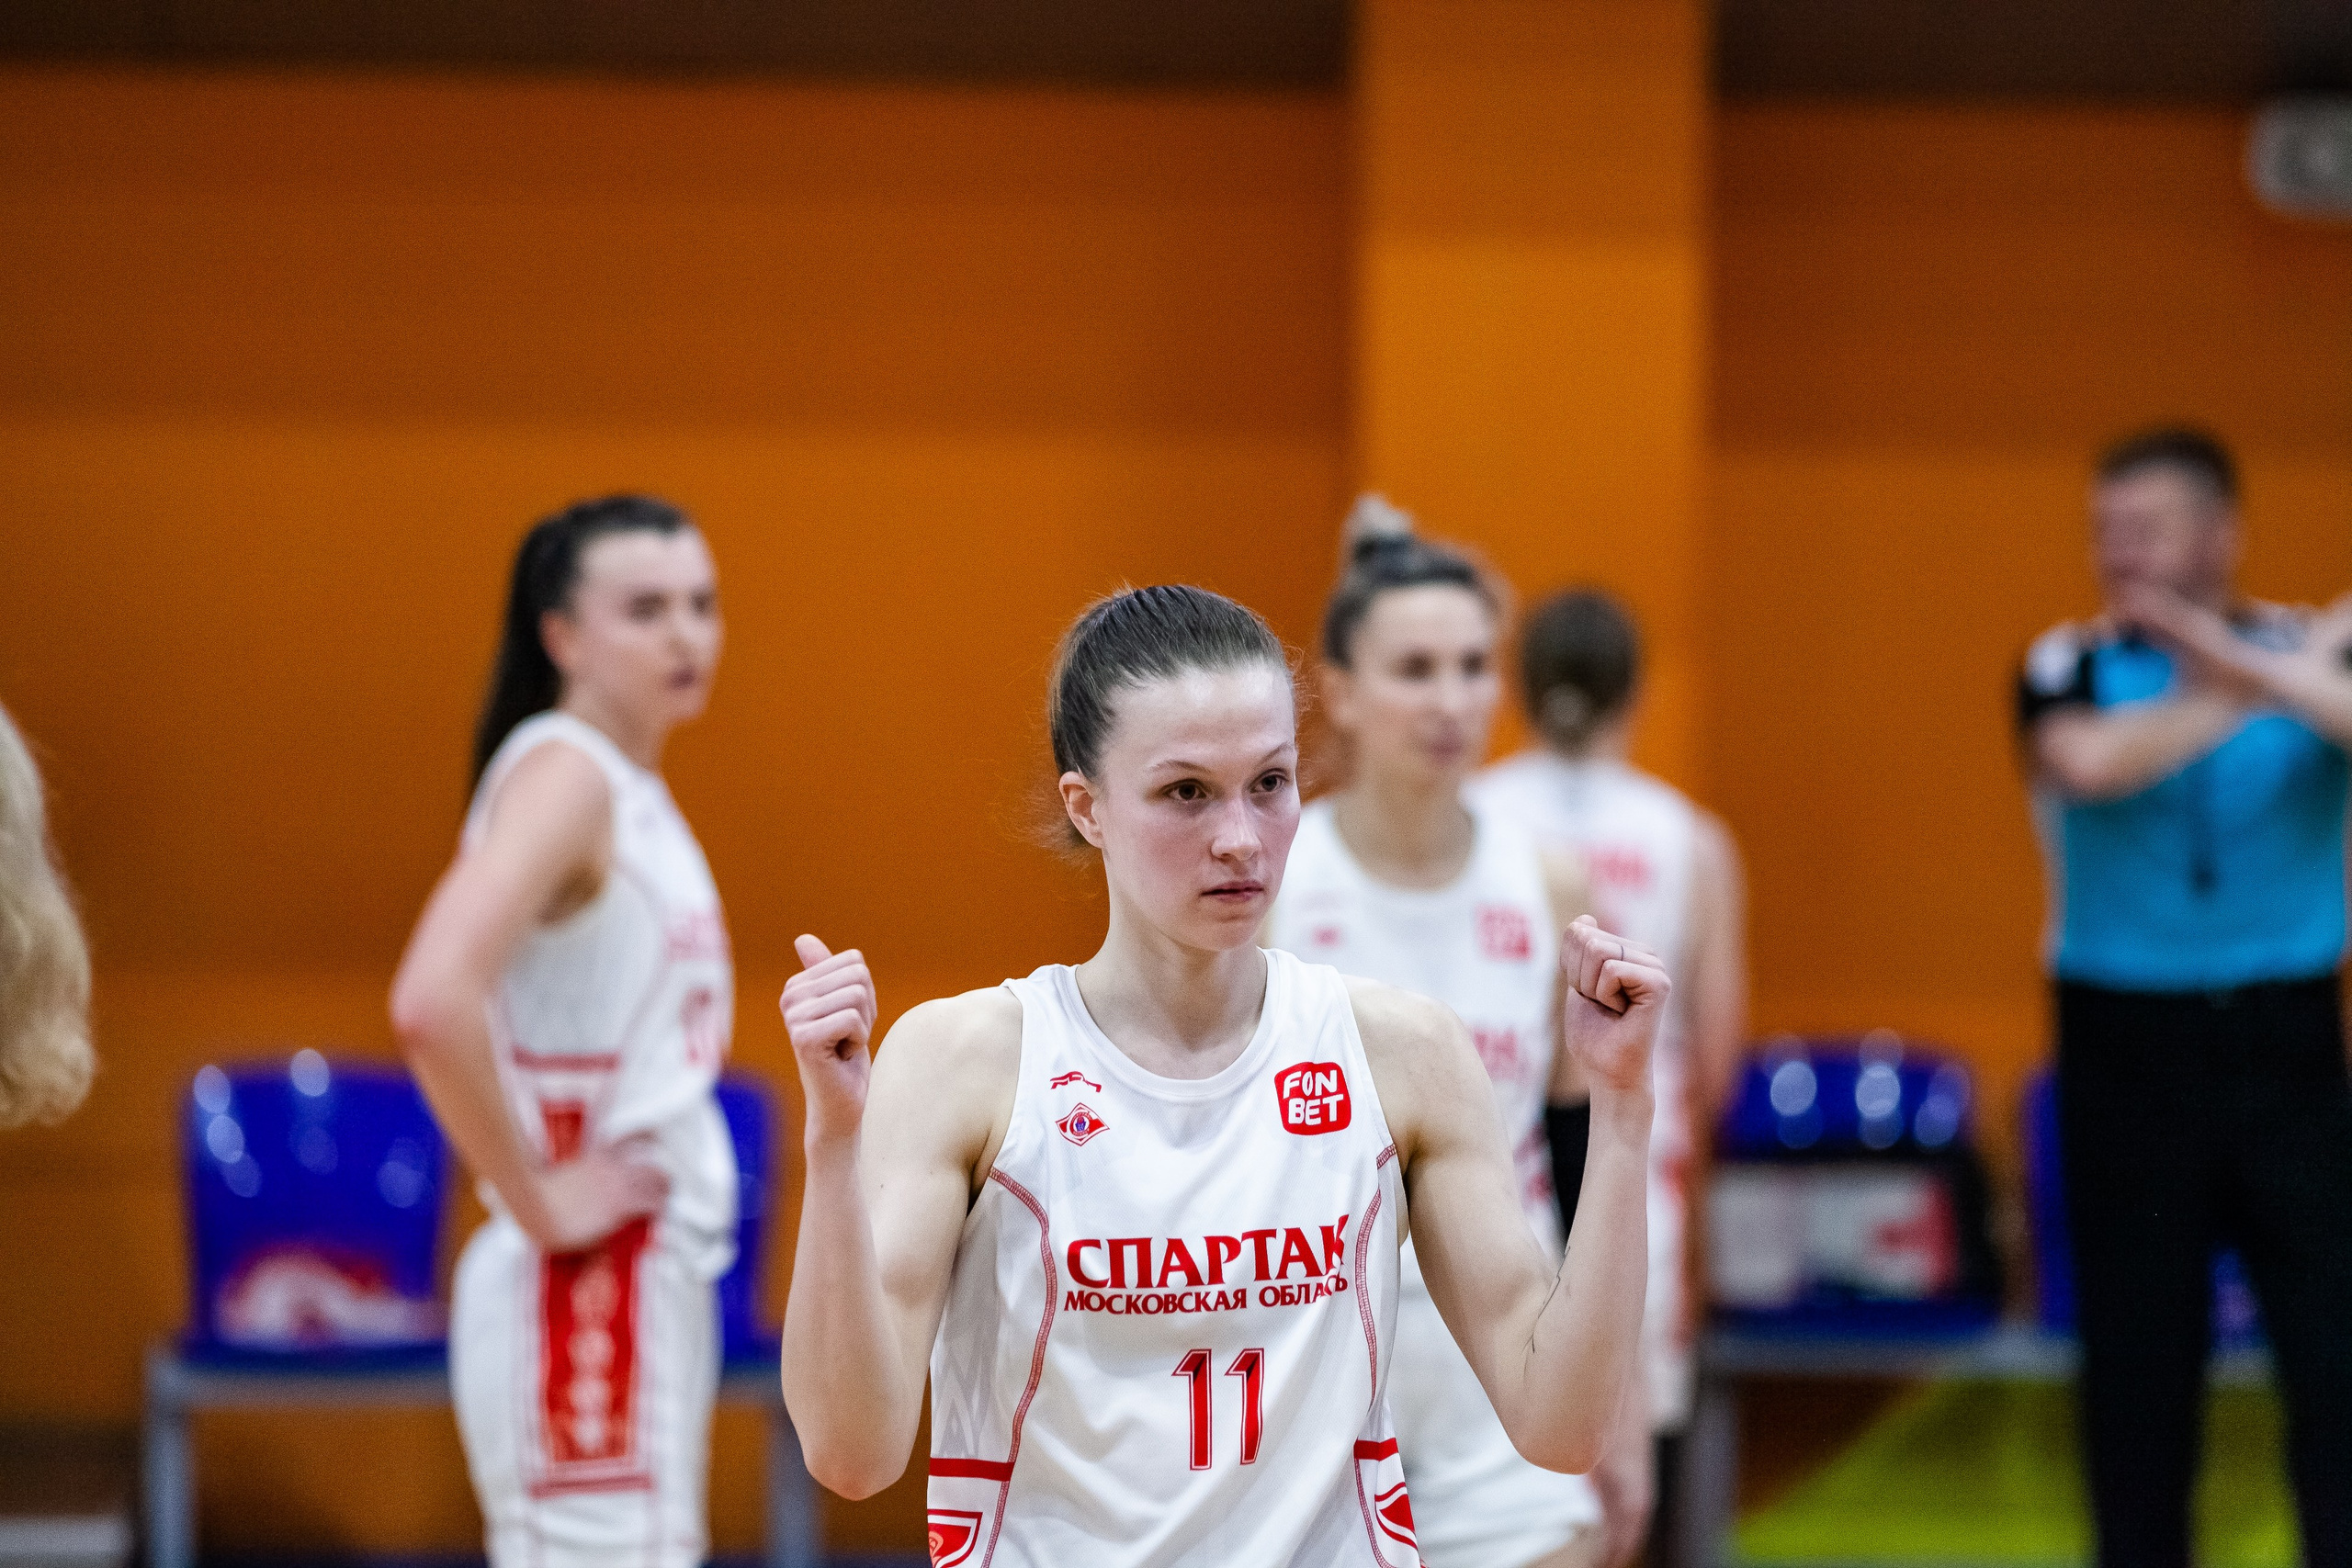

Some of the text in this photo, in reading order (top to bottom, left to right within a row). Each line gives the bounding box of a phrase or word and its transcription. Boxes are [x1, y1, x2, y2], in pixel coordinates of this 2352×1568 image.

[1283, 1069, 1338, 1100] FON
[1288, 1093, 1344, 1126] BET
[1067, 1213, 1350, 1289] СПАРТАК
[1064, 1270, 1349, 1315] МОСКОВСКАЯ ОБЛАСЬ
[1170, 1347, 1265, 1472] 11
